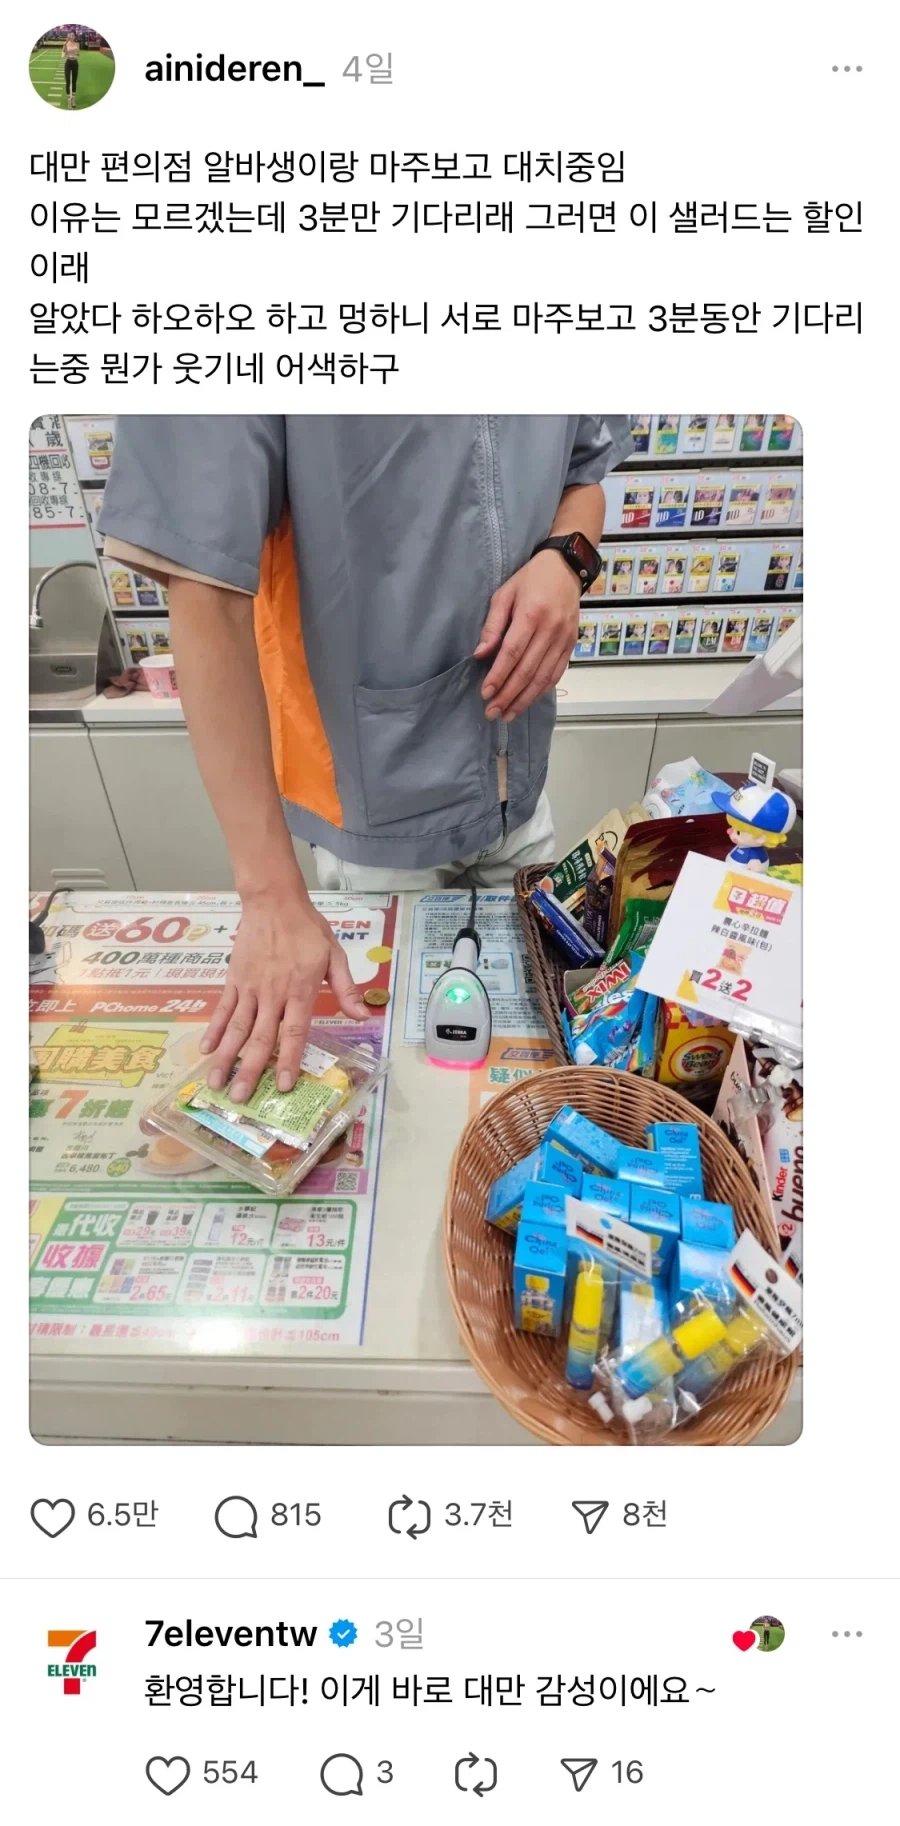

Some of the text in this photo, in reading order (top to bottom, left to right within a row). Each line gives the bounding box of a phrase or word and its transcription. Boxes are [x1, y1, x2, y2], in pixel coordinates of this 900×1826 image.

[328, 920, 371, 929] PEN
[690, 968, 752, 1002] 買2送2
[90, 1001, 159, 1013] PChome
